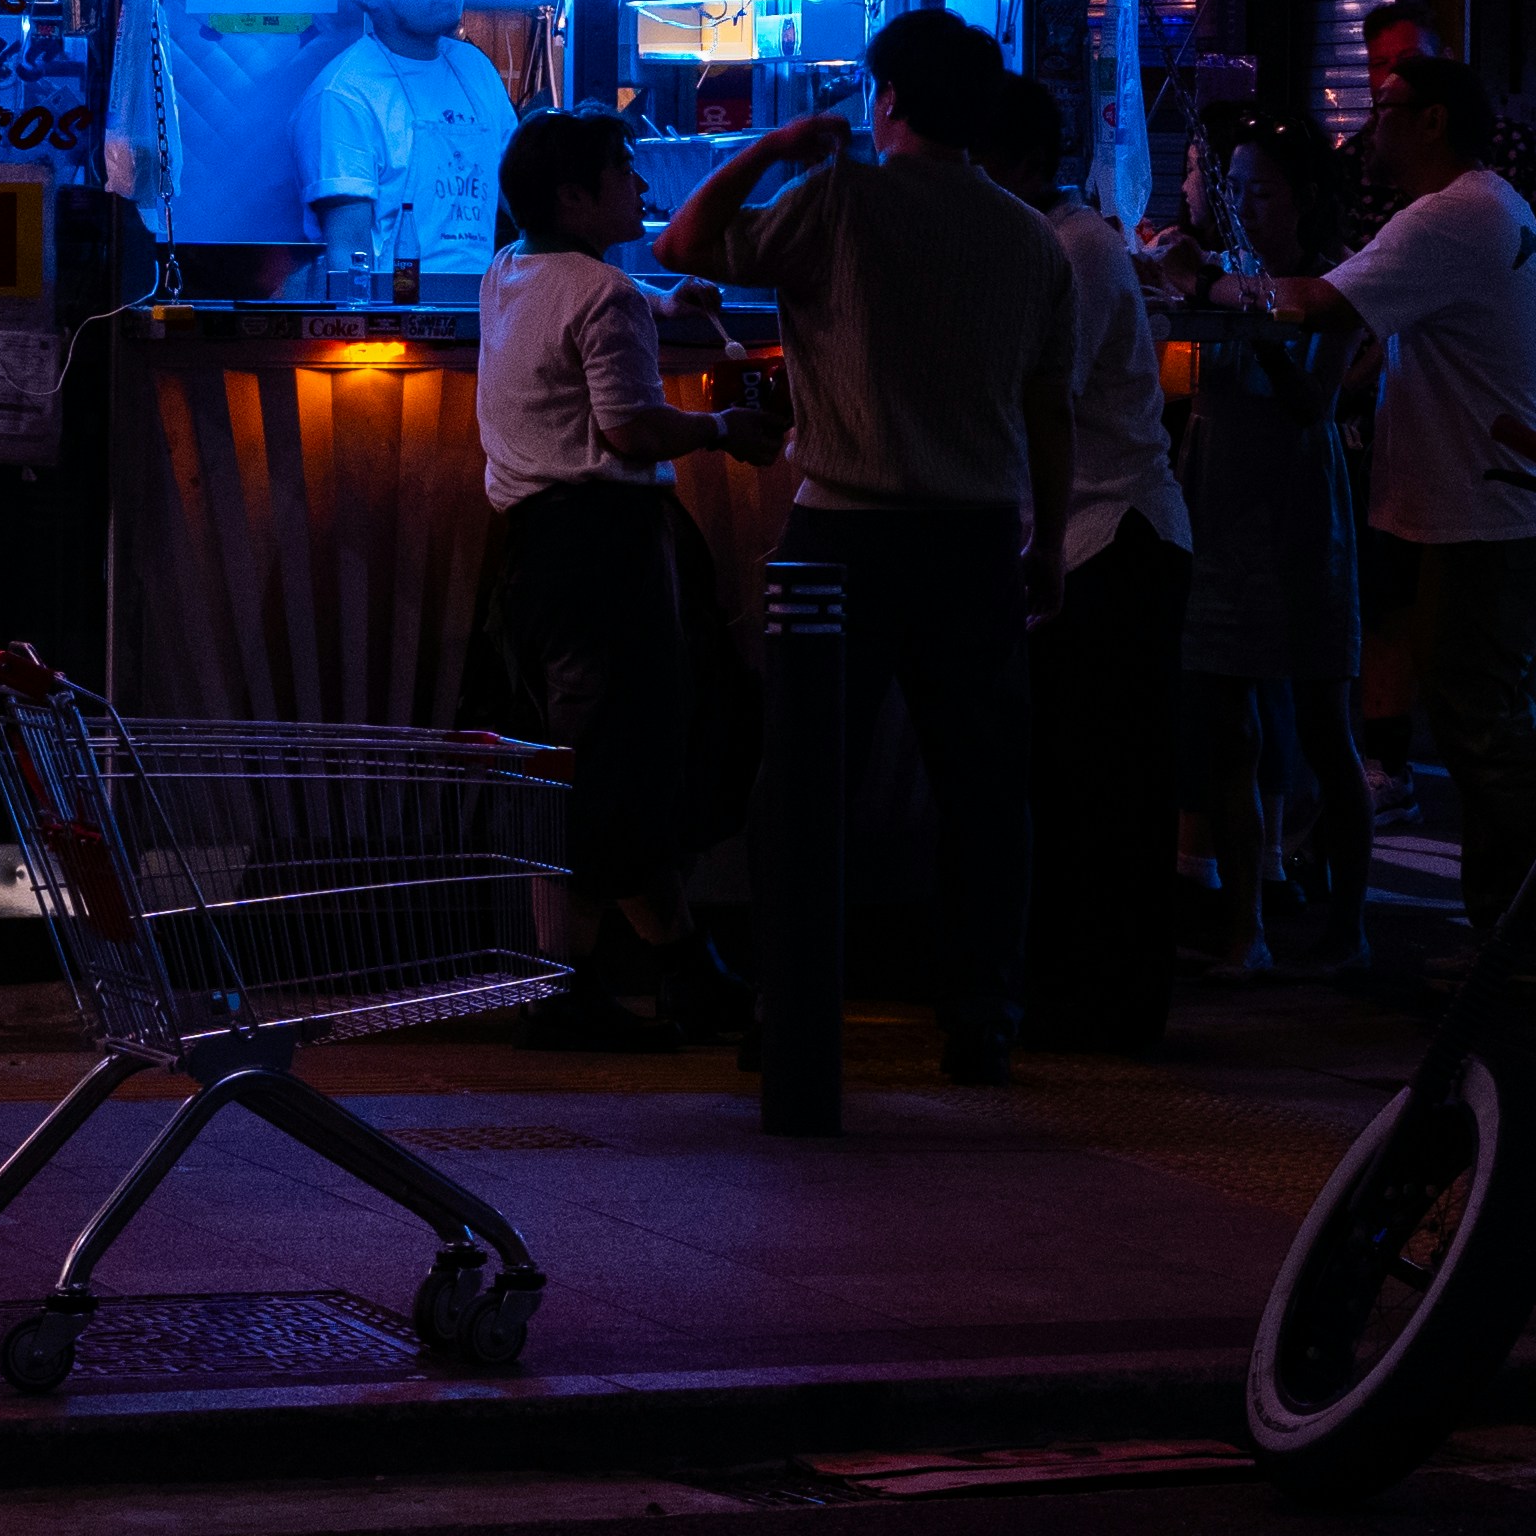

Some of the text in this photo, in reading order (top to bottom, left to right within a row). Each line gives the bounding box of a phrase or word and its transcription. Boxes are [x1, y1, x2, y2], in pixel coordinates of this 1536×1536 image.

[435, 175, 489, 202] OLDIES
[450, 203, 482, 222] TACO
[308, 318, 359, 337] Coke
